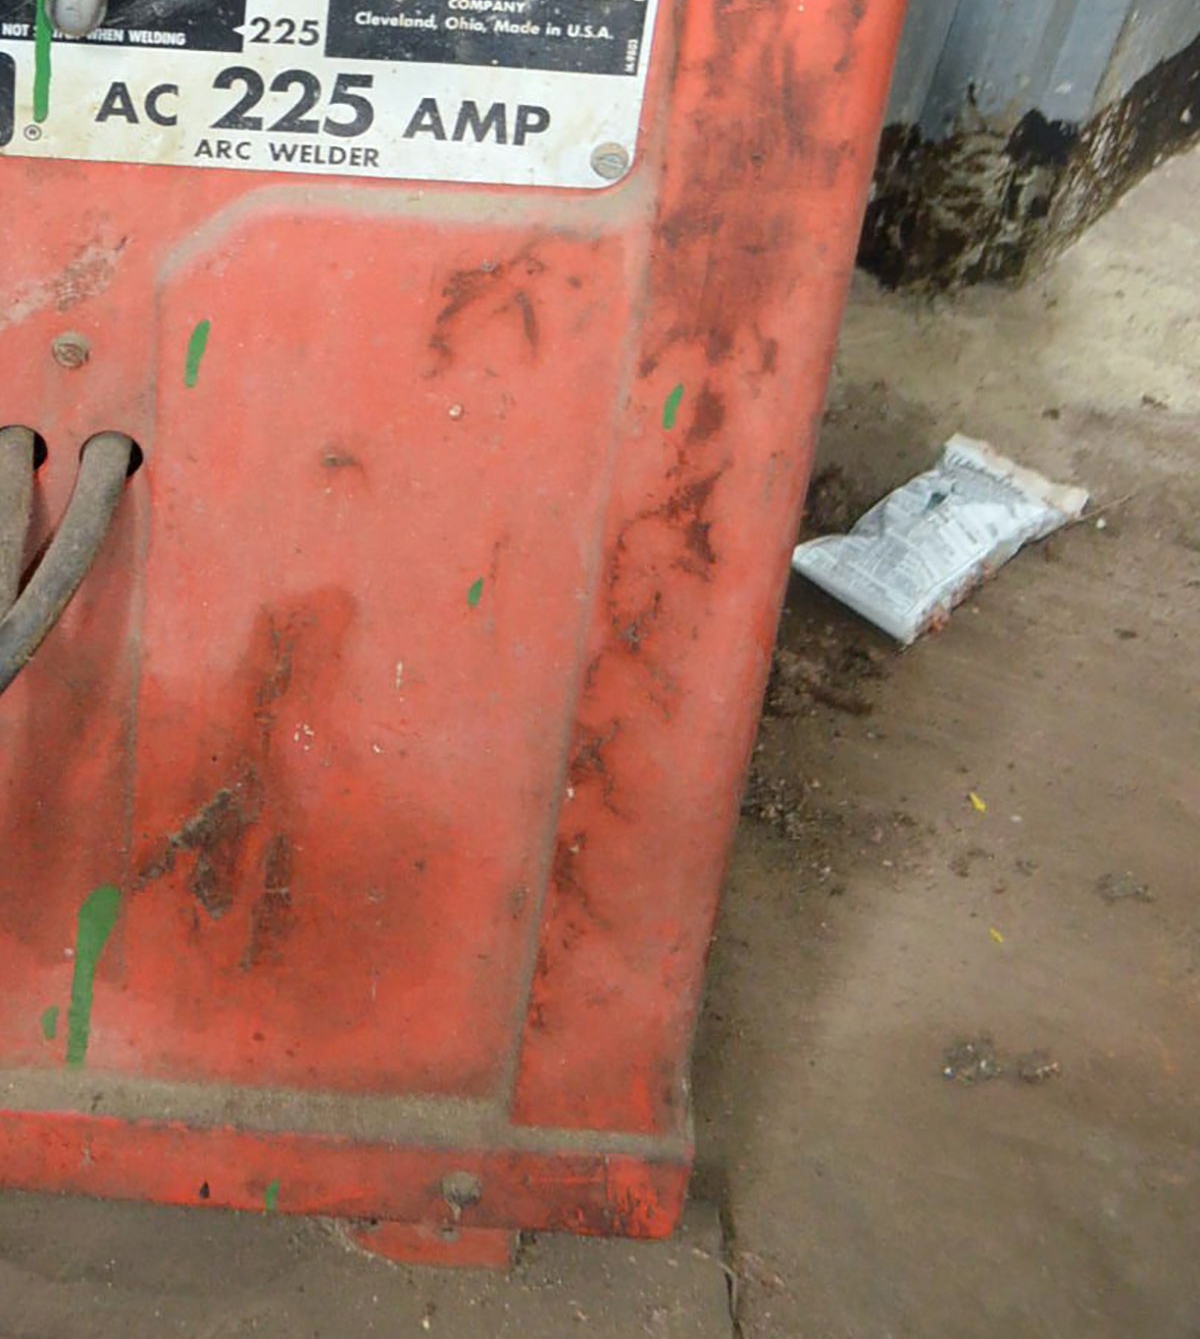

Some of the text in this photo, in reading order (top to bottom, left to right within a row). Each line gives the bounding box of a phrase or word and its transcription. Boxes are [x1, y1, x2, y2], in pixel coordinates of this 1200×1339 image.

[2, 23, 29, 37] NOT
[129, 30, 186, 45] WELDING
[249, 17, 320, 46] 225
[354, 12, 614, 39] Cleveland, Ohio, Made in U.S.A.
[95, 65, 551, 147] AC 225 AMP
[194, 139, 380, 168] ARC WELDER
